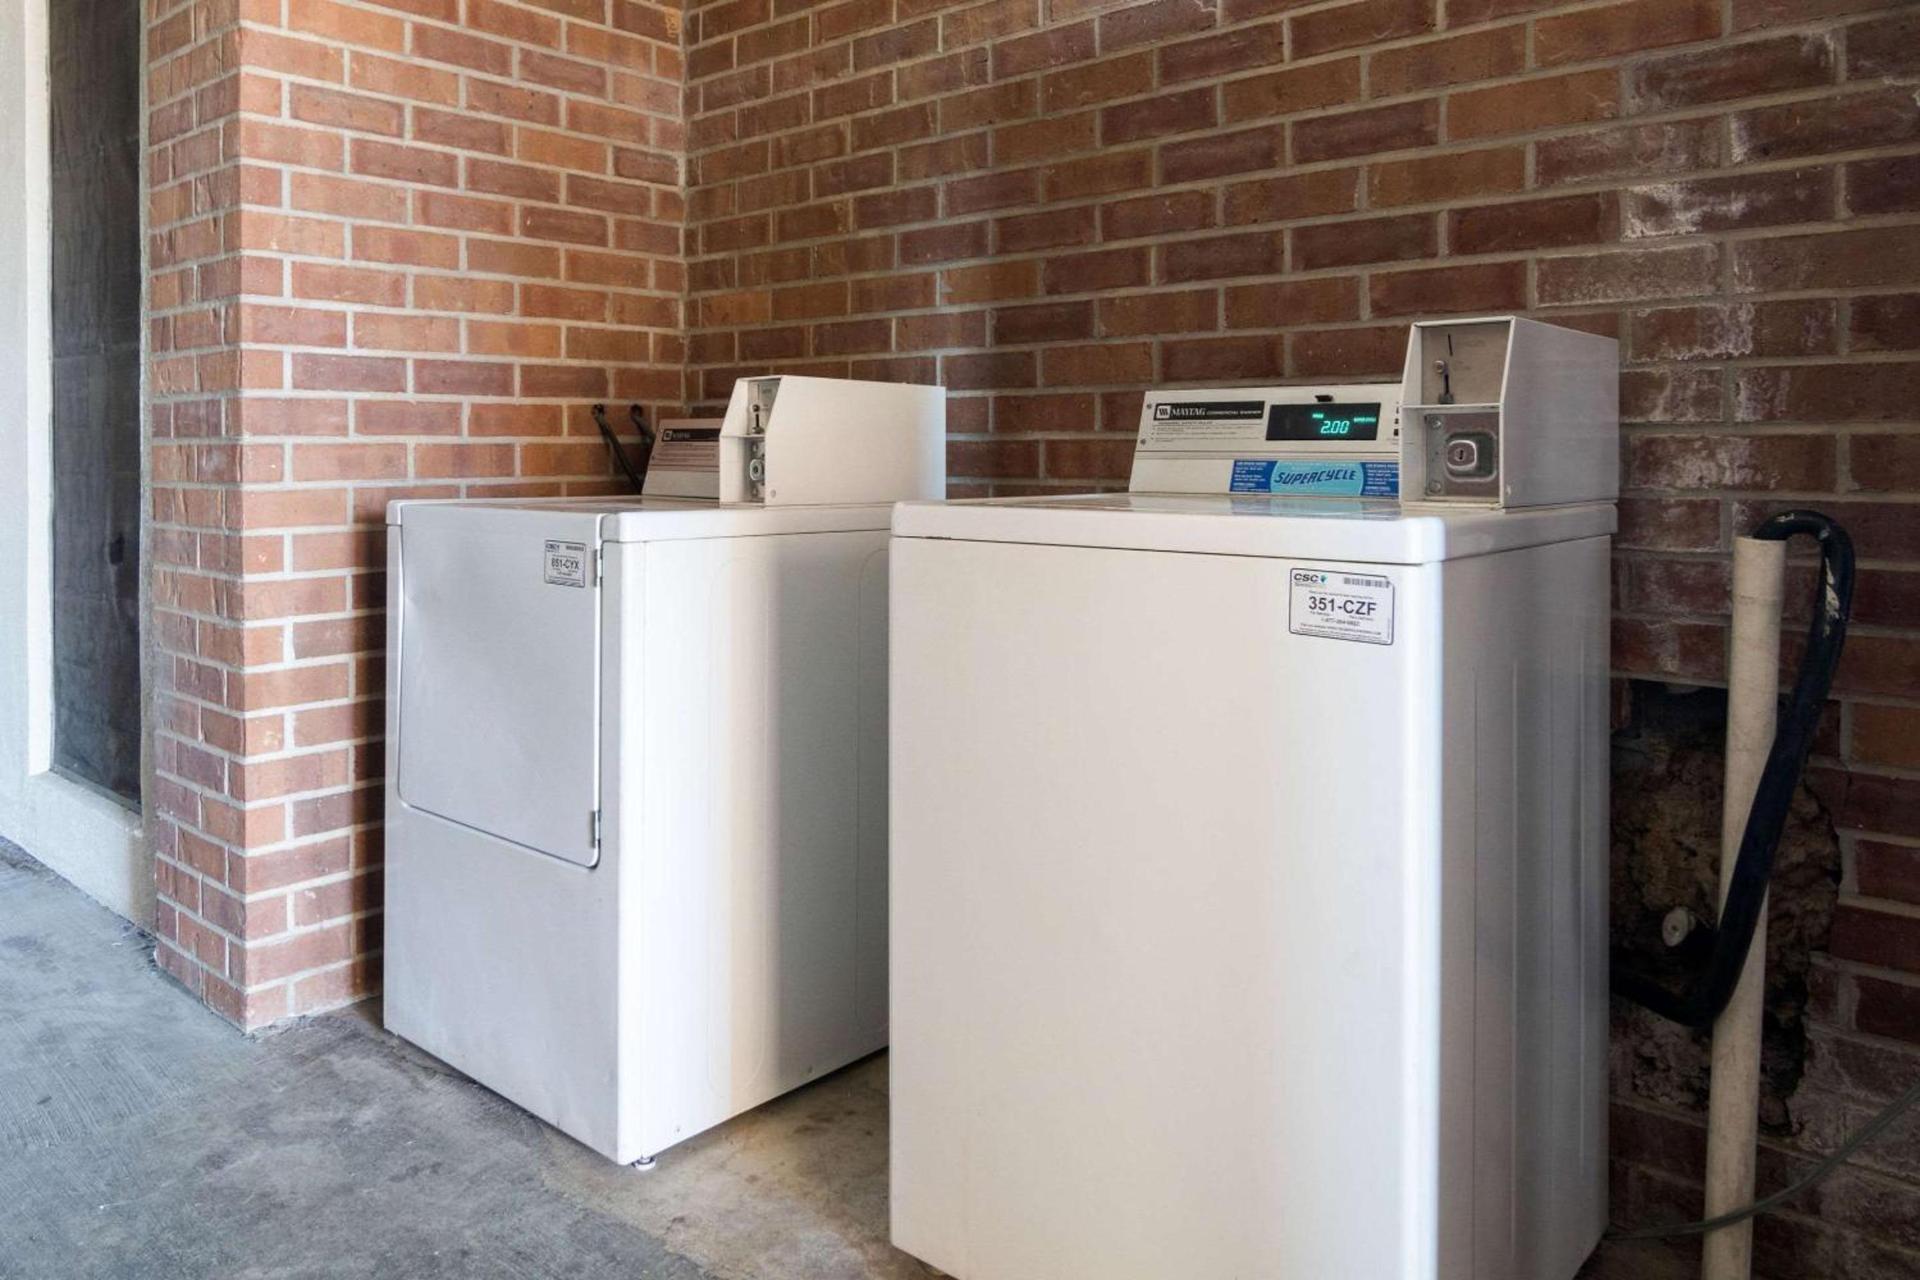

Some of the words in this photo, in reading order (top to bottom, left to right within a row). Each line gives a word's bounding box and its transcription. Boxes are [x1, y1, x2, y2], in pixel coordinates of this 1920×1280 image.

[1170, 407, 1206, 417] MAYTAG
[1320, 420, 1350, 434] 2.00
[1274, 468, 1357, 485] SUPERCYCLE
[1294, 573, 1319, 583] CSC
[1308, 596, 1377, 616] 351-CZF
